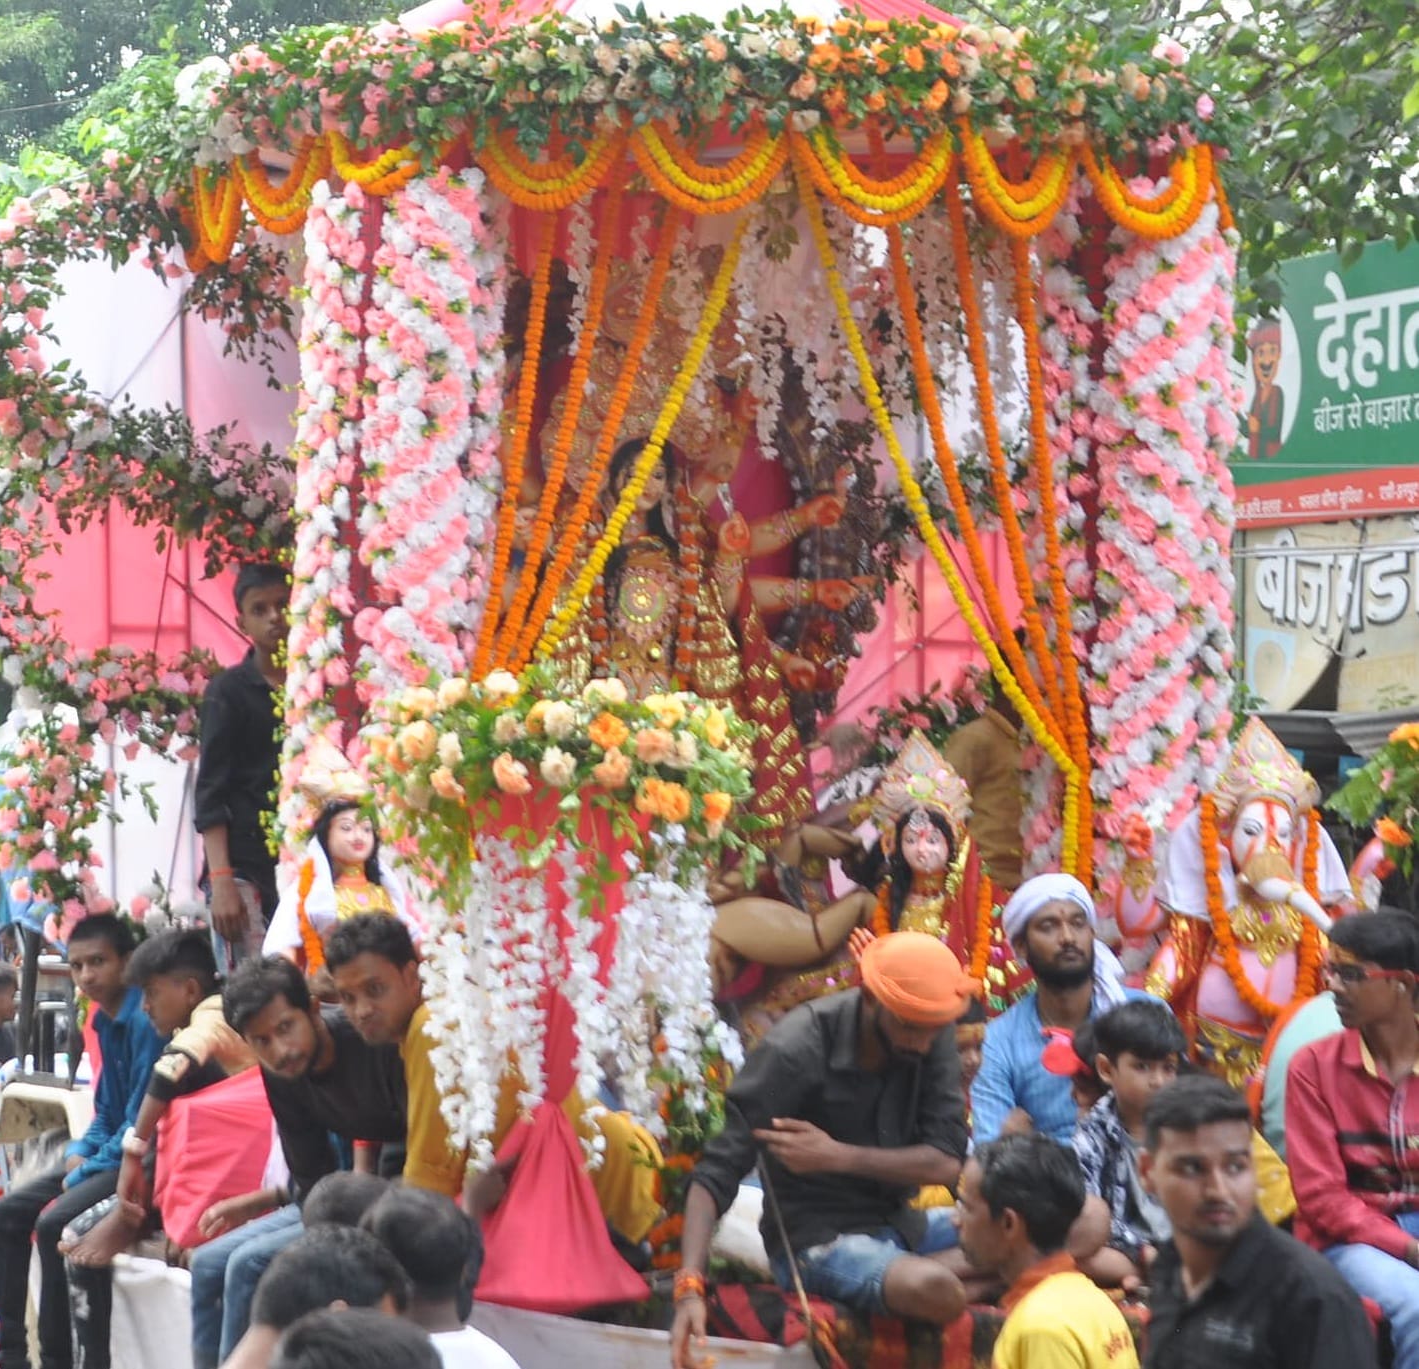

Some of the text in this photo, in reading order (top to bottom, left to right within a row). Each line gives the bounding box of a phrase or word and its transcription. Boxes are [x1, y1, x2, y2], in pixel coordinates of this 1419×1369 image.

[1313, 397, 1344, 433] बीज
[1347, 393, 1363, 429] से
[1255, 528, 1334, 634] बीज
